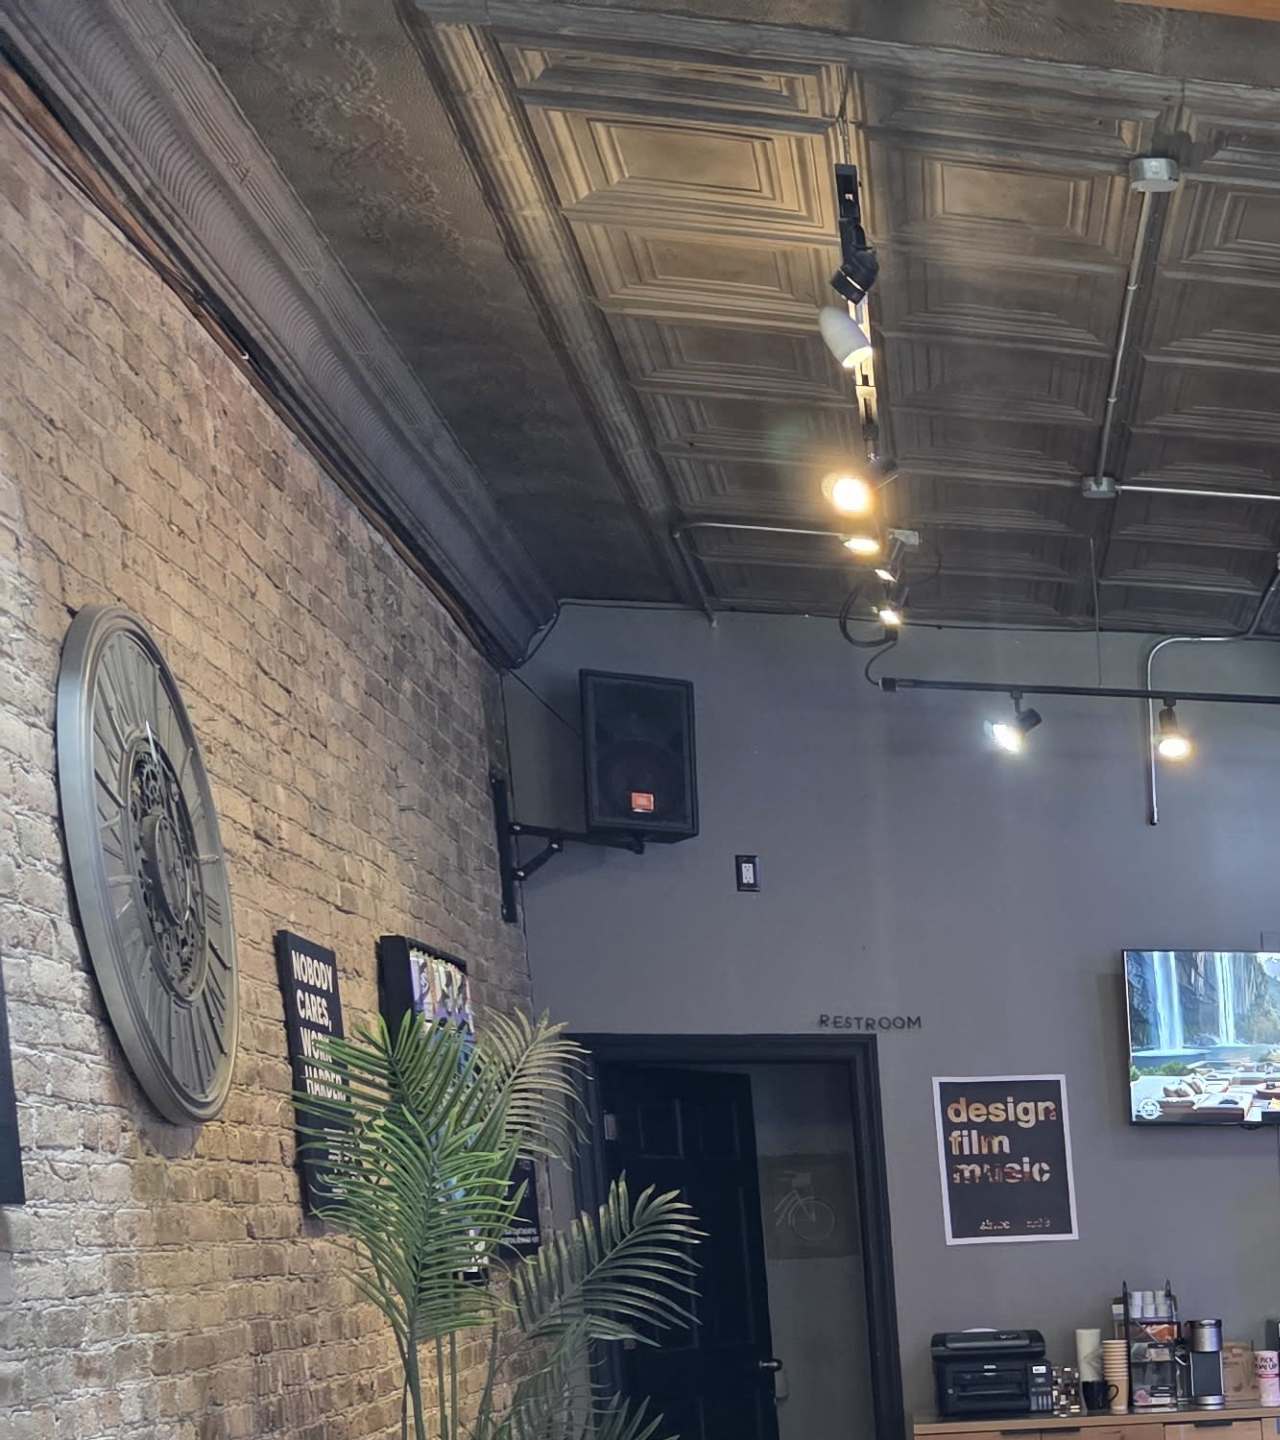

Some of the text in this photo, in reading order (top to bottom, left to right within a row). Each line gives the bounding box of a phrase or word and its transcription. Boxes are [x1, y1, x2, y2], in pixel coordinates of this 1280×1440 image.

[291, 950, 333, 993] NOBODY
[296, 989, 332, 1031] CARES,
[818, 1014, 922, 1031] RESTROOM
[947, 1096, 1056, 1128] design
[949, 1129, 1011, 1155] film
[952, 1157, 1051, 1183] music
